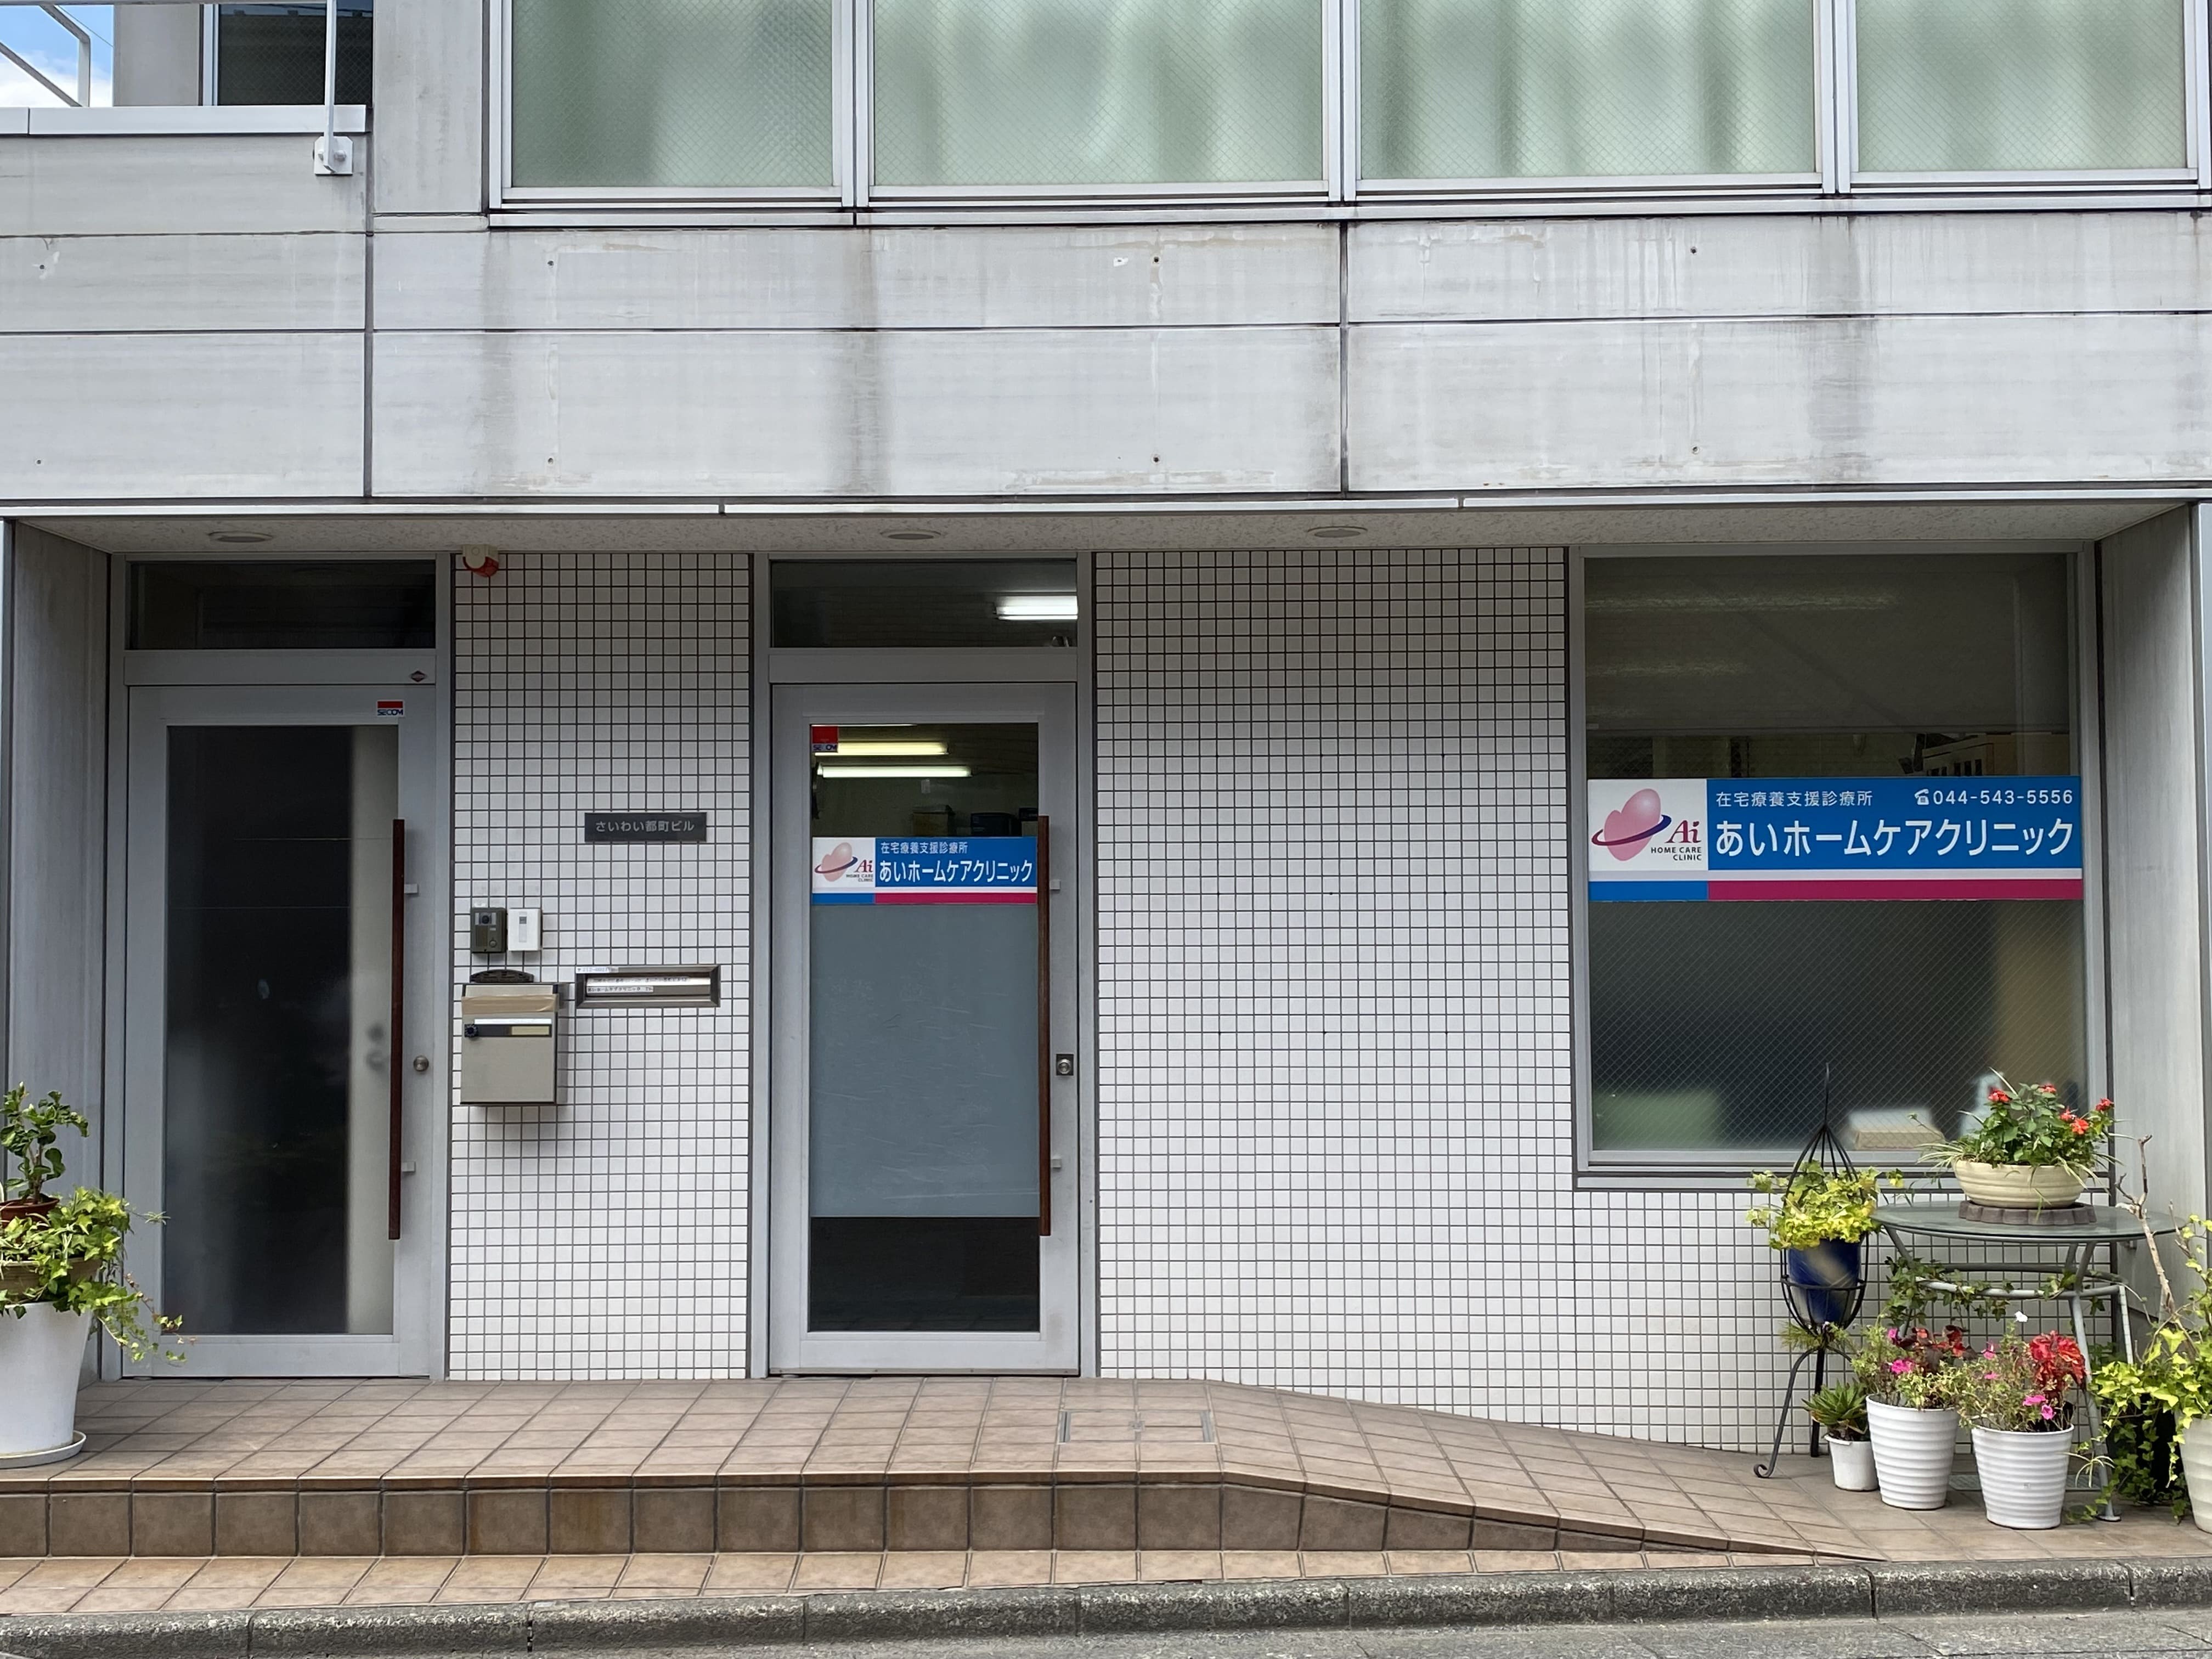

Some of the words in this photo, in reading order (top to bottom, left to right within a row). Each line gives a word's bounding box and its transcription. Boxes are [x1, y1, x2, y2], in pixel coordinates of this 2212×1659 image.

[1716, 791, 1873, 807] 在宅療養支援診療所
[1933, 789, 2073, 805] 044-543-5556
[596, 820, 695, 832] さいわい都町ビル
[1664, 820, 1702, 843] Ai
[1716, 818, 2073, 856] あいホームケアクリニック
[880, 842, 968, 854] 在宅療養支援診療所
[854, 859, 873, 872] Ai
[879, 860, 1032, 883] あいホームケアクリニック
